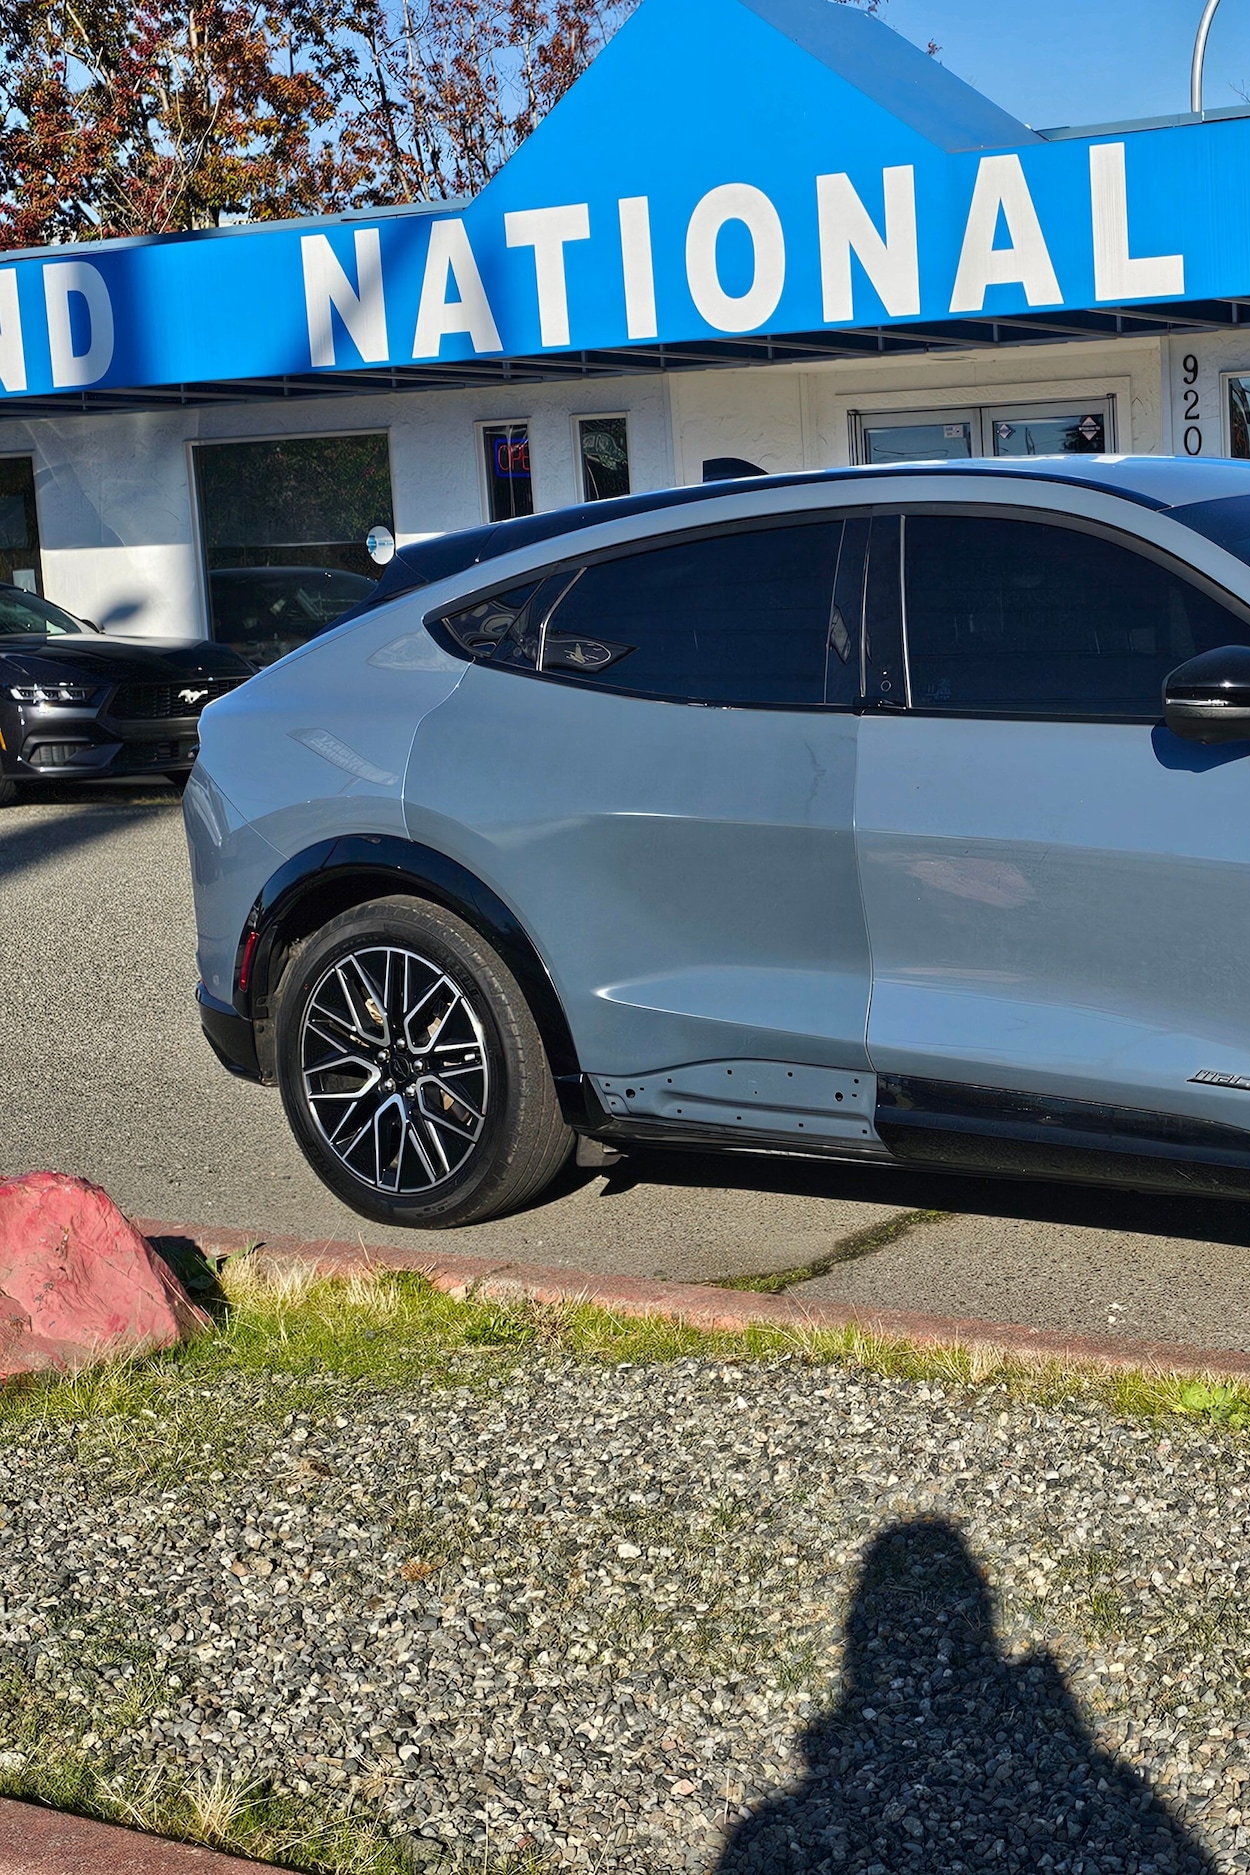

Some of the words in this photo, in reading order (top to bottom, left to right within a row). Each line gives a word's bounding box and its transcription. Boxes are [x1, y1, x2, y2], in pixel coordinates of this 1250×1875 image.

[0, 261, 114, 392] D
[301, 142, 1185, 367] NATIONAL
[1182, 354, 1202, 456] 920
